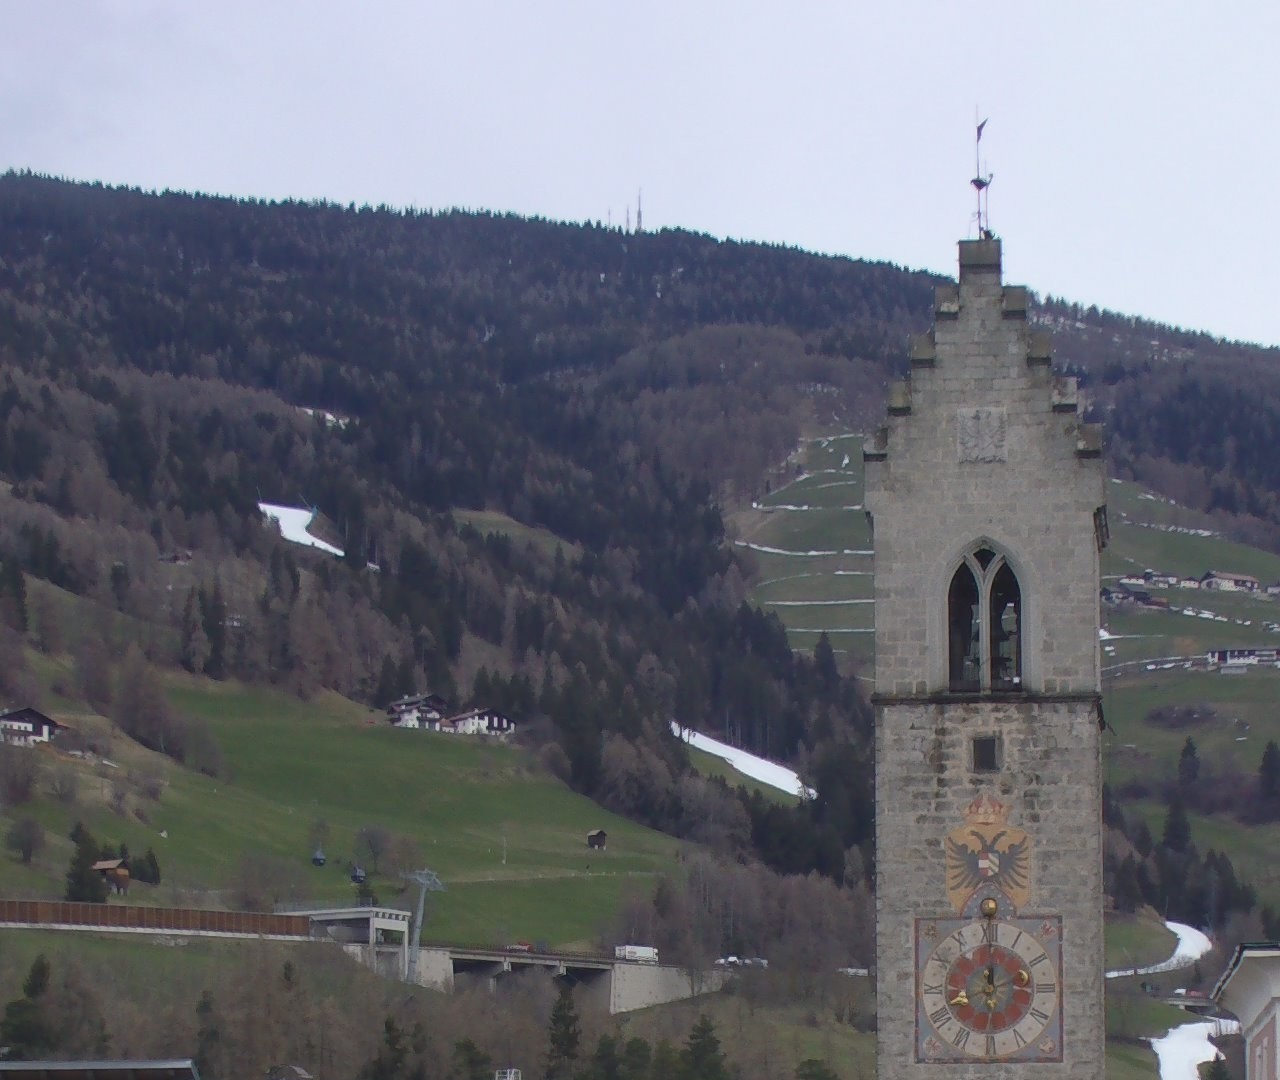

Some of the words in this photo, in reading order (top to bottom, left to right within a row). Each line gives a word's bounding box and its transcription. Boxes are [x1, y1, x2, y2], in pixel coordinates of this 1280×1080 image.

[1011, 931, 1023, 949] I
[1028, 951, 1048, 968] II
[923, 983, 943, 995] IX
[1035, 983, 1056, 994] III
[1012, 1028, 1027, 1049] V
